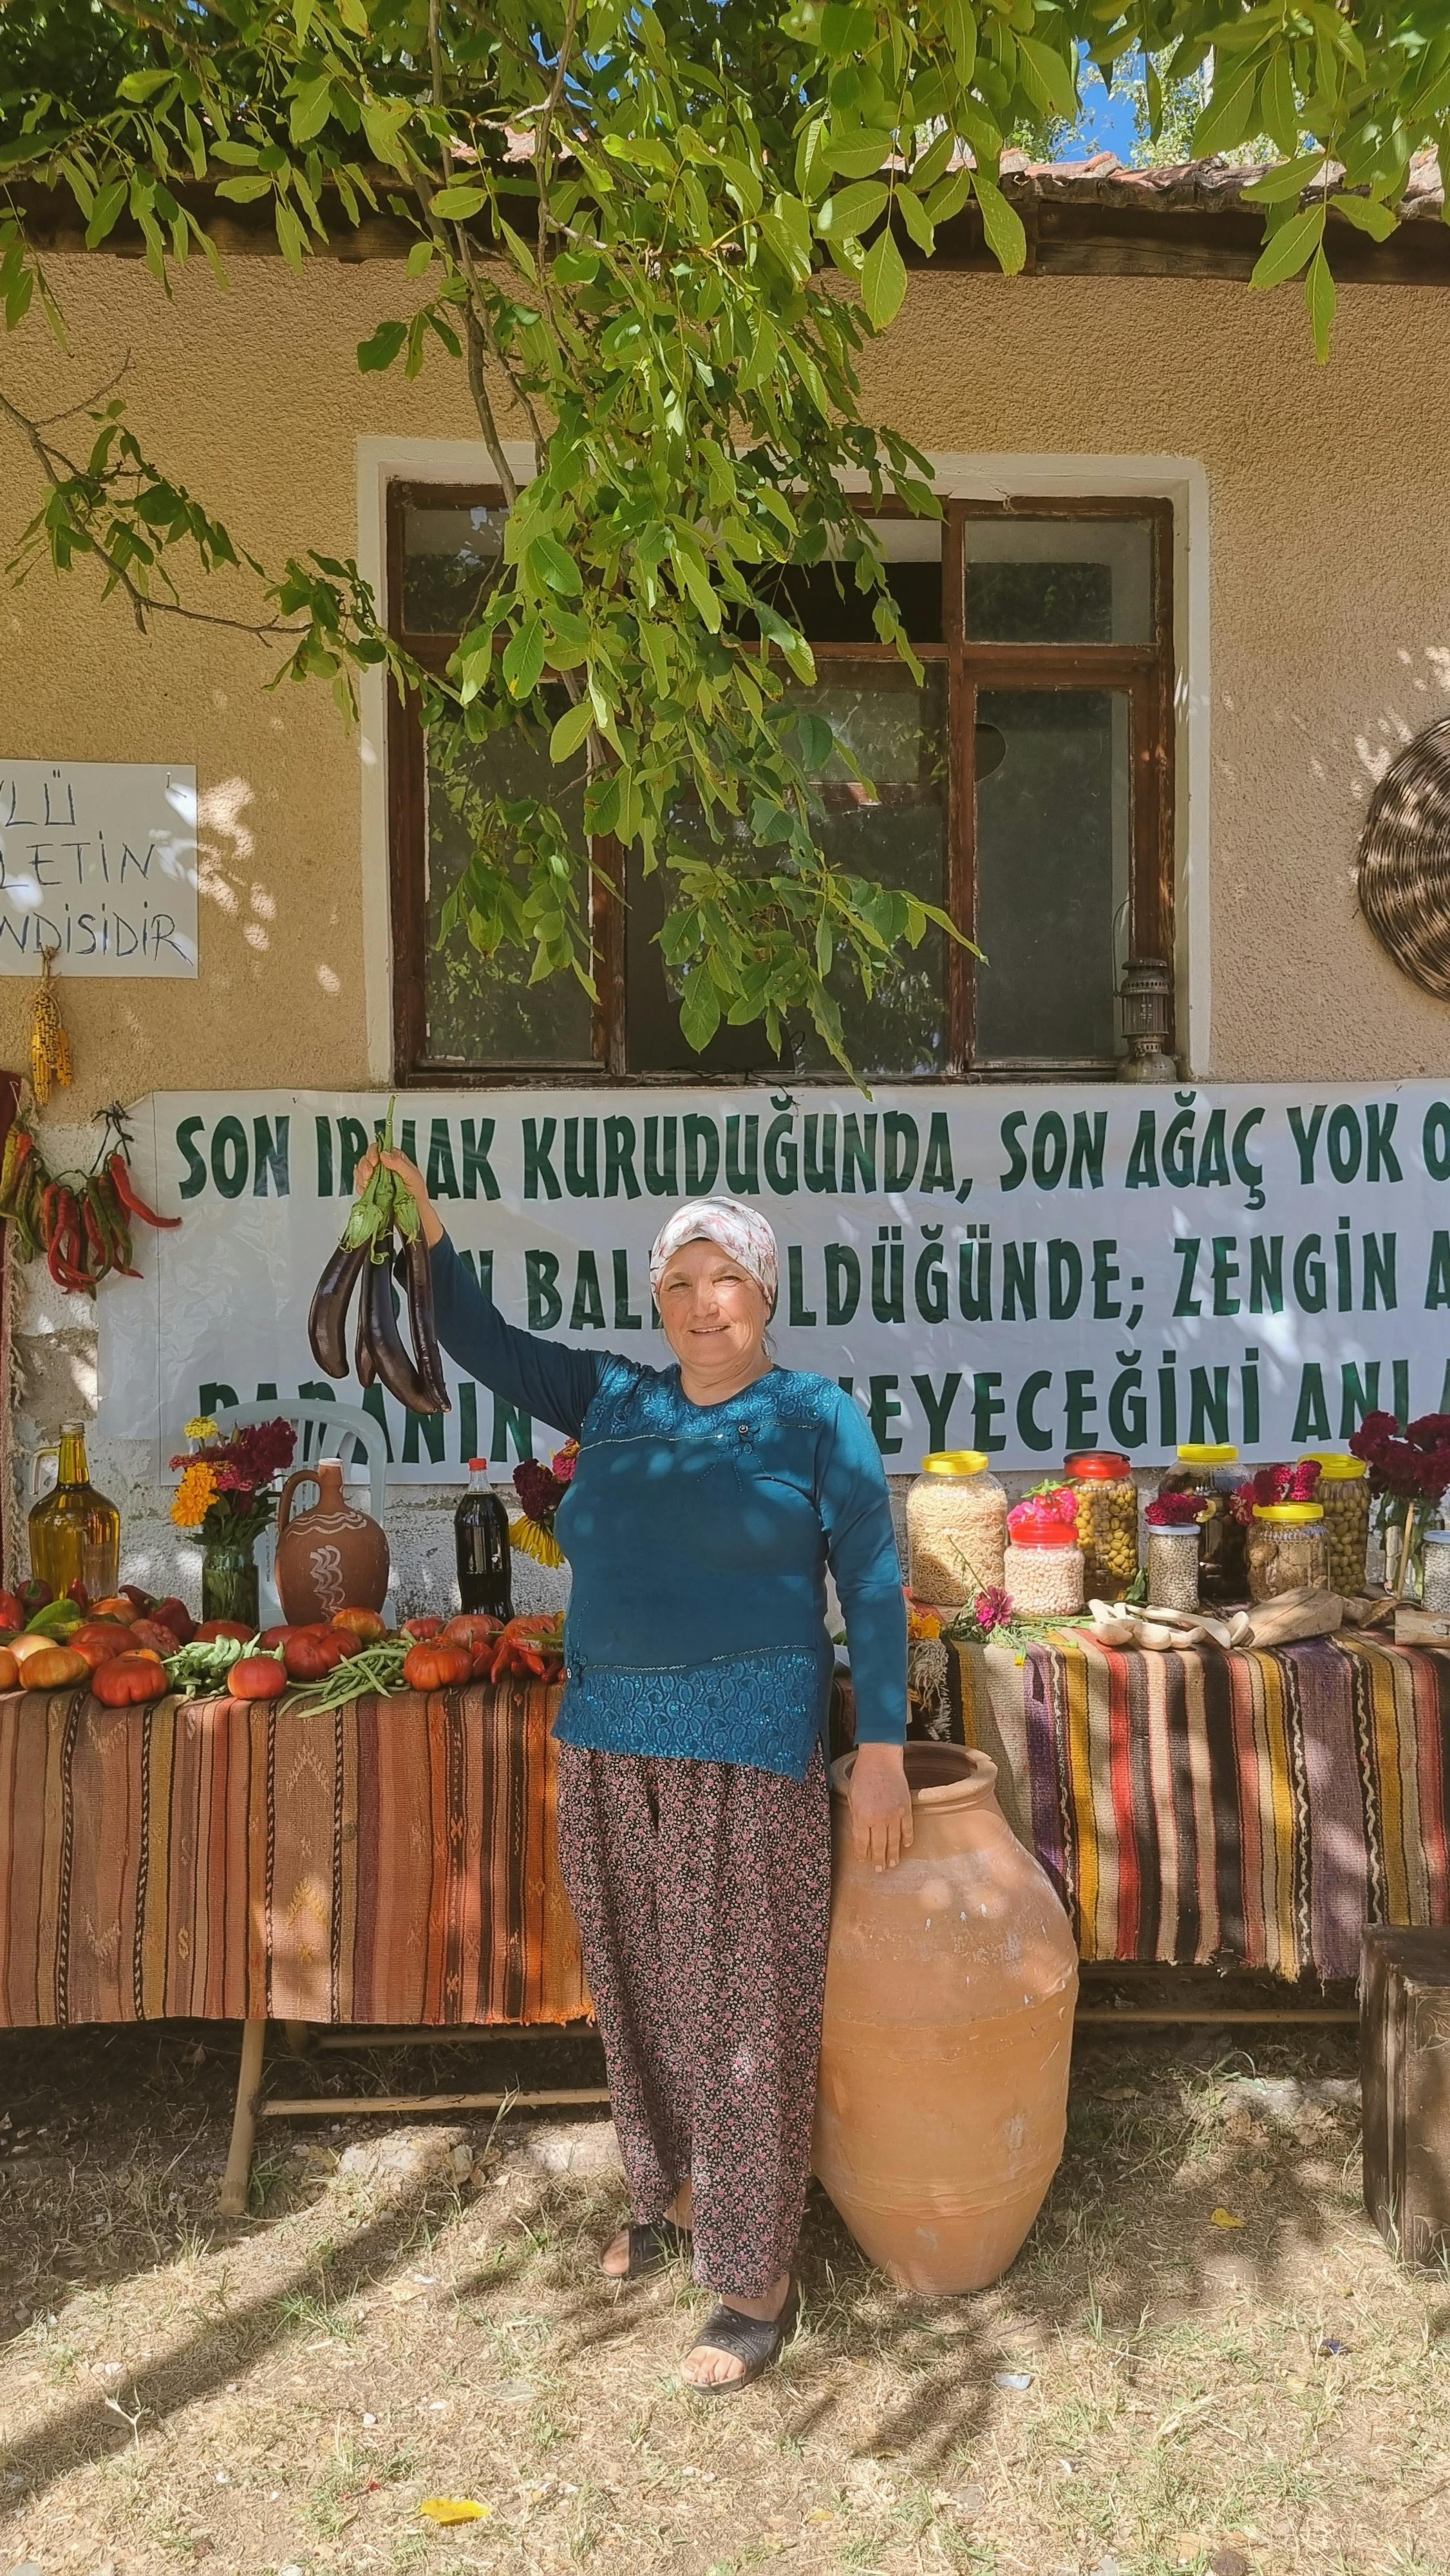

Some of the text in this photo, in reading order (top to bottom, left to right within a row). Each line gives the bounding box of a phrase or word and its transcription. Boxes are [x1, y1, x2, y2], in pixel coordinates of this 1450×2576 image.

[0, 769, 76, 827] LÜ
[176, 1115, 290, 1200] SON
[522, 1095, 973, 1204] KURUDUĞUNDA,
[999, 1110, 1108, 1192] SON
[1125, 1091, 1266, 1210] AĞAÇ
[1286, 1102, 1404, 1183] YOK
[766, 1224, 1144, 1331] LDÜĞÜNDE;
[1172, 1216, 1398, 1318] ZENGİN
[838, 1347, 1259, 1458] EYECEĞİNİ
